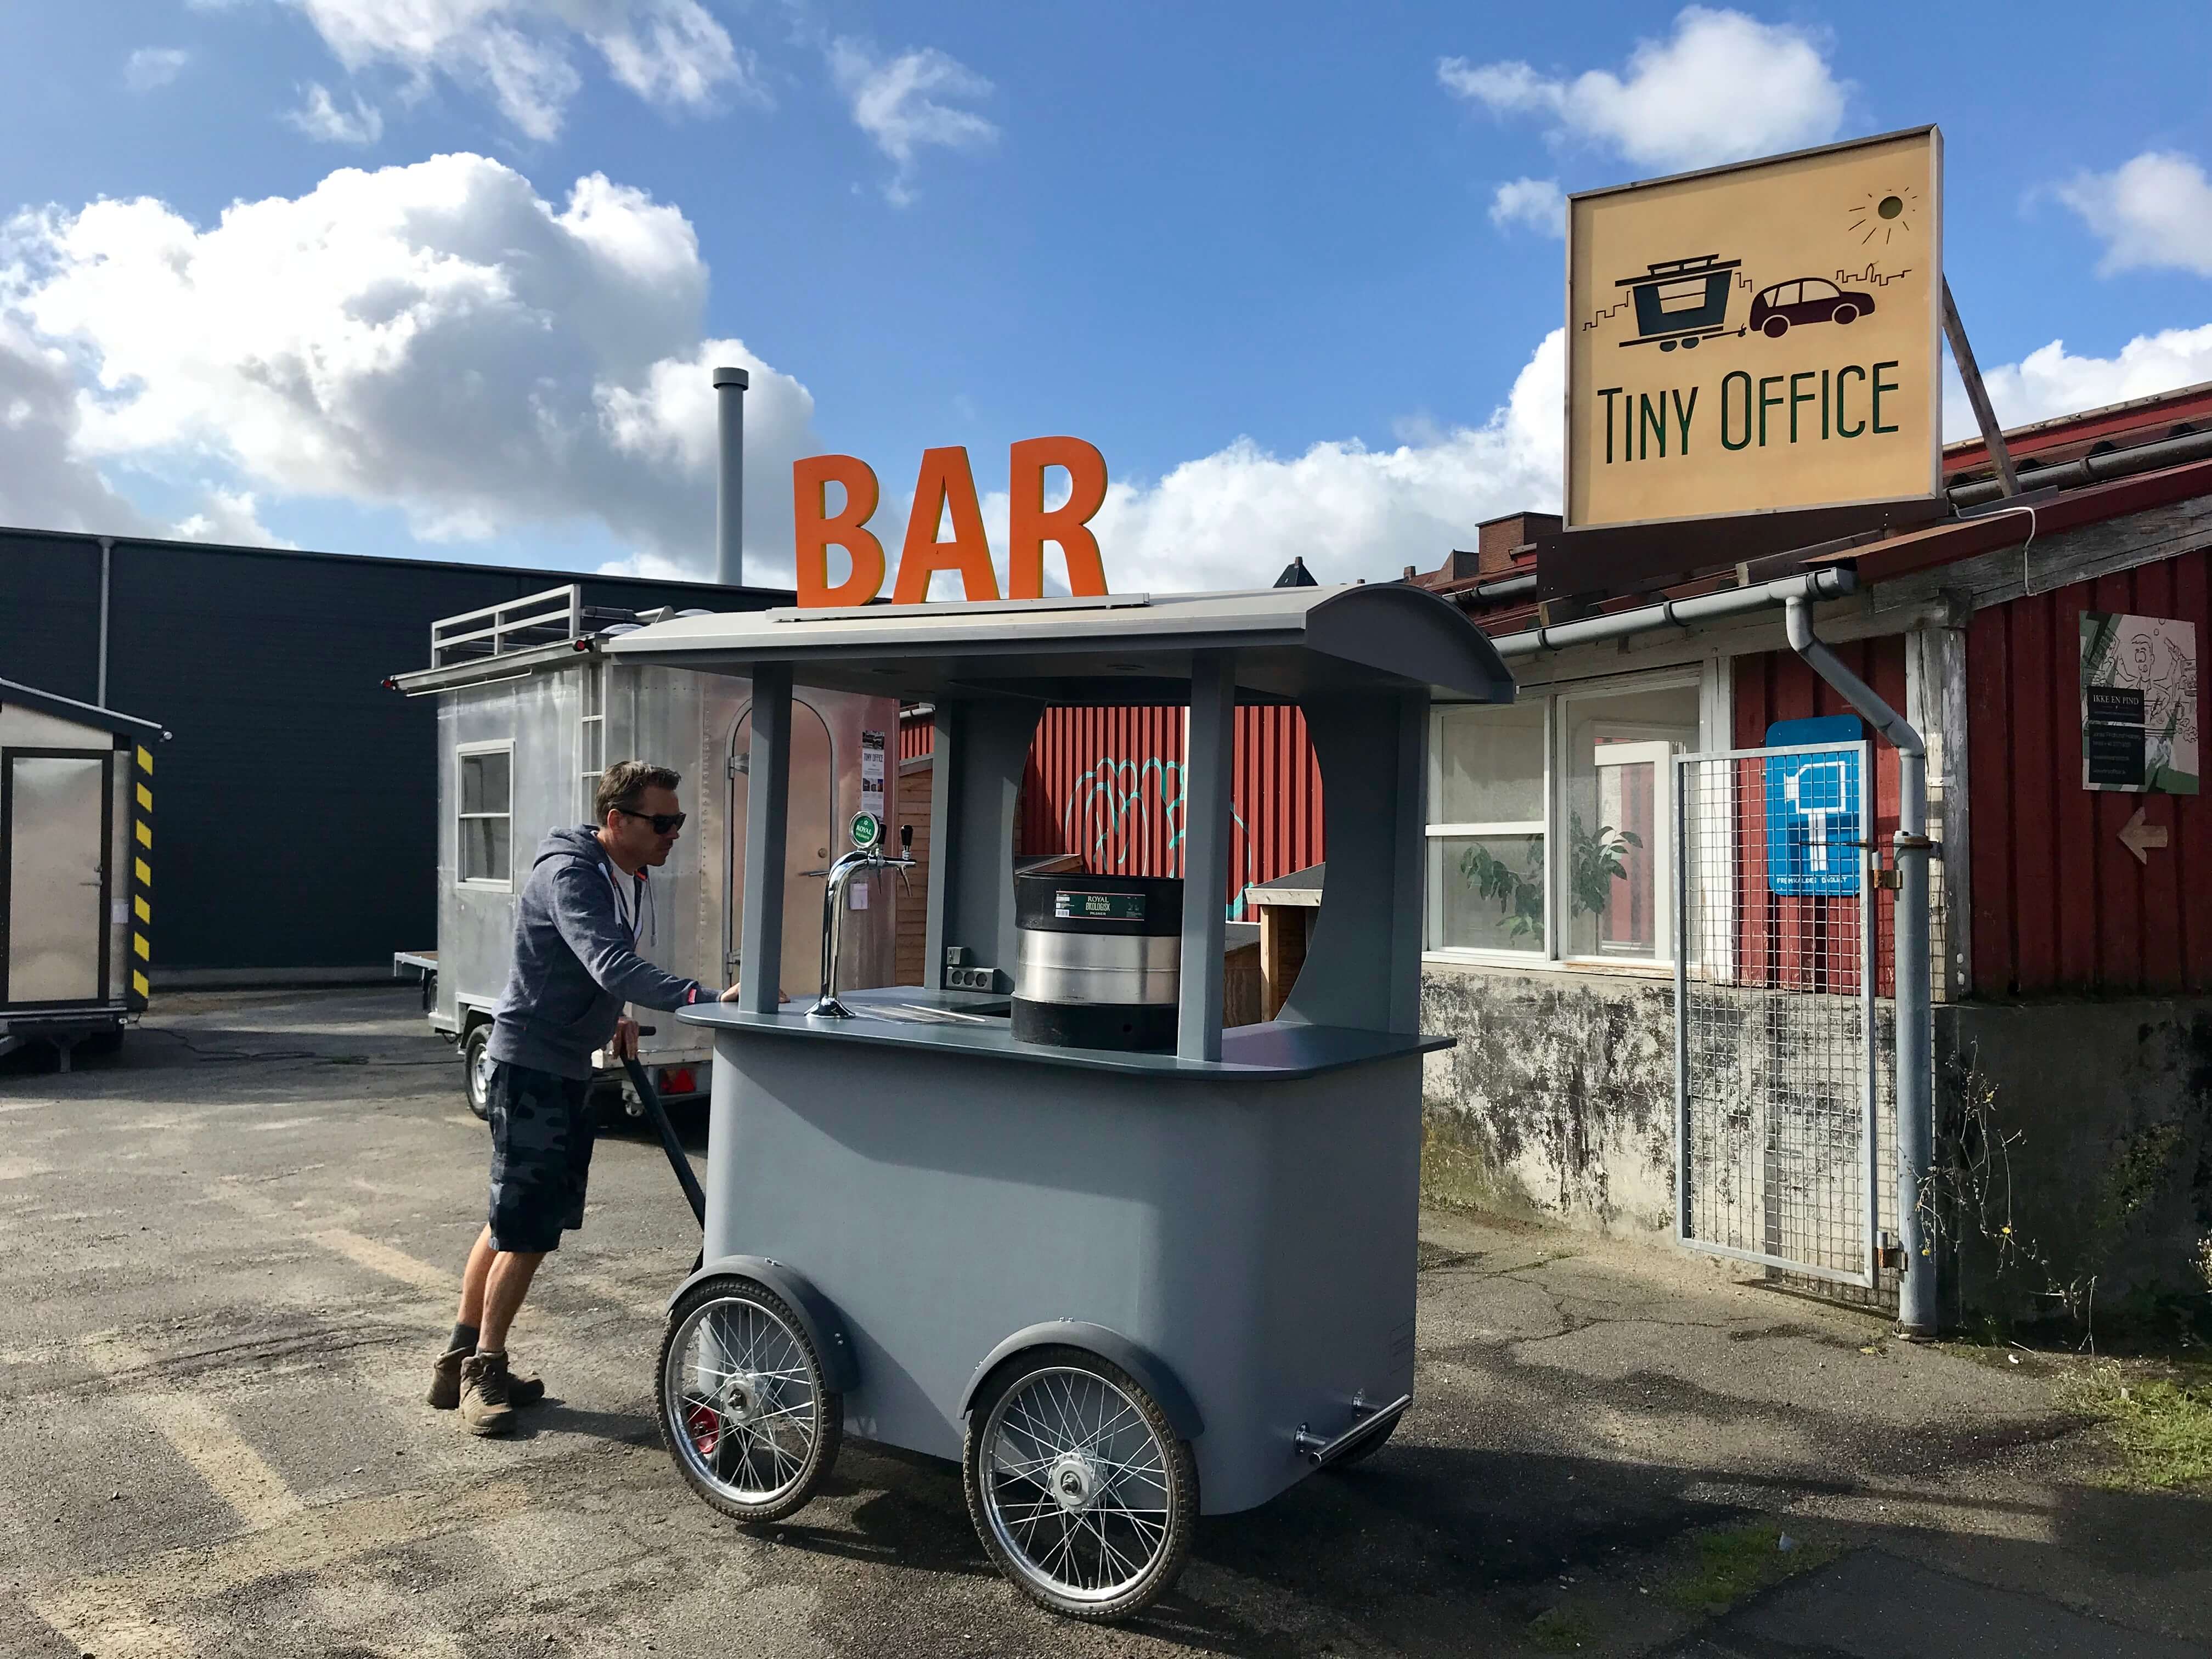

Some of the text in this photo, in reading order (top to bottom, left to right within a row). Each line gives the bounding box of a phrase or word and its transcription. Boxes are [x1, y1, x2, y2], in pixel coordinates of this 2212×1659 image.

[1597, 360, 1899, 464] TINY OFFICE
[793, 436, 1109, 608] BAR
[2093, 695, 2109, 703] IKKE
[2123, 697, 2139, 705] PIND
[856, 825, 872, 835] ROYAL
[1085, 902, 1110, 911] ØKOLOGISK
